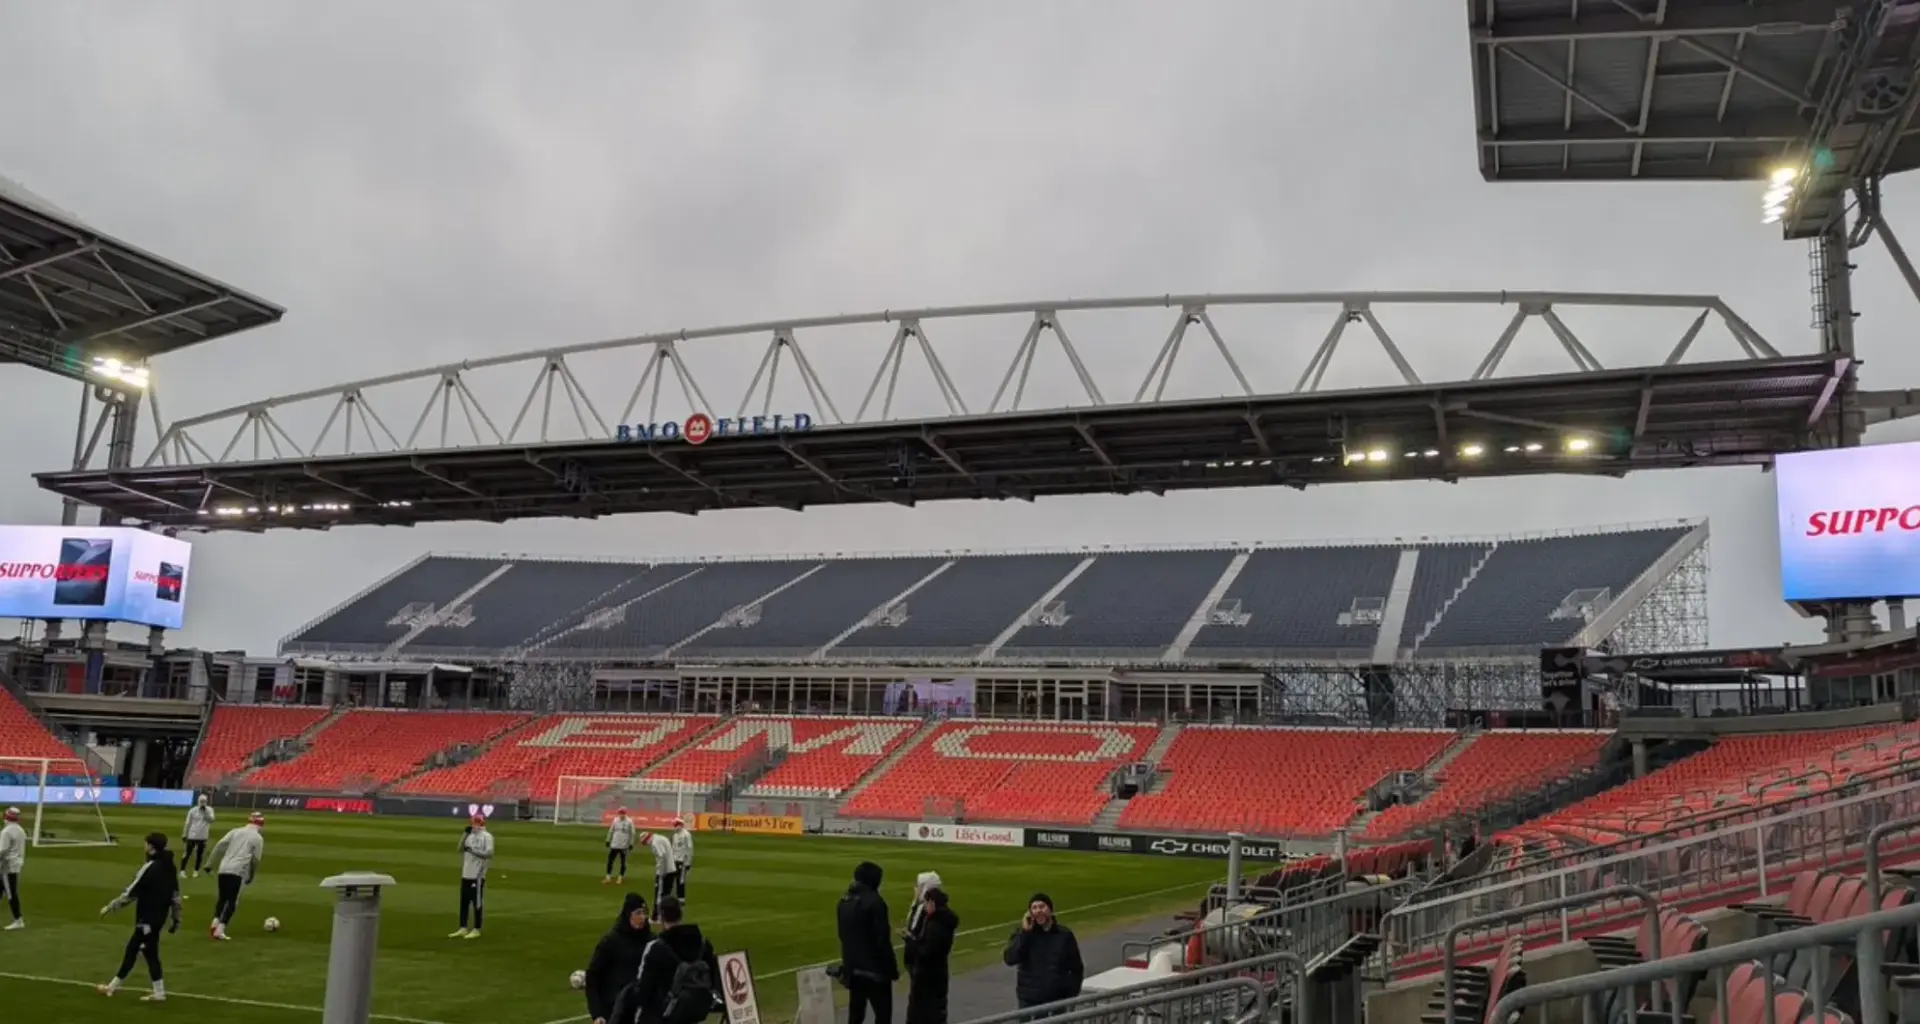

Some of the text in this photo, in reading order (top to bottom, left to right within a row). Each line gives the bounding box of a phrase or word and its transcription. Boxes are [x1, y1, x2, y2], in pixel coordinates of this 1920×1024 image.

[616, 413, 812, 443] BMO FIELD
[1661, 656, 1724, 667] CHEVROLET
[518, 718, 1137, 764] BMO
[931, 828, 944, 838] LG
[1192, 843, 1277, 857] CHEVOLET
